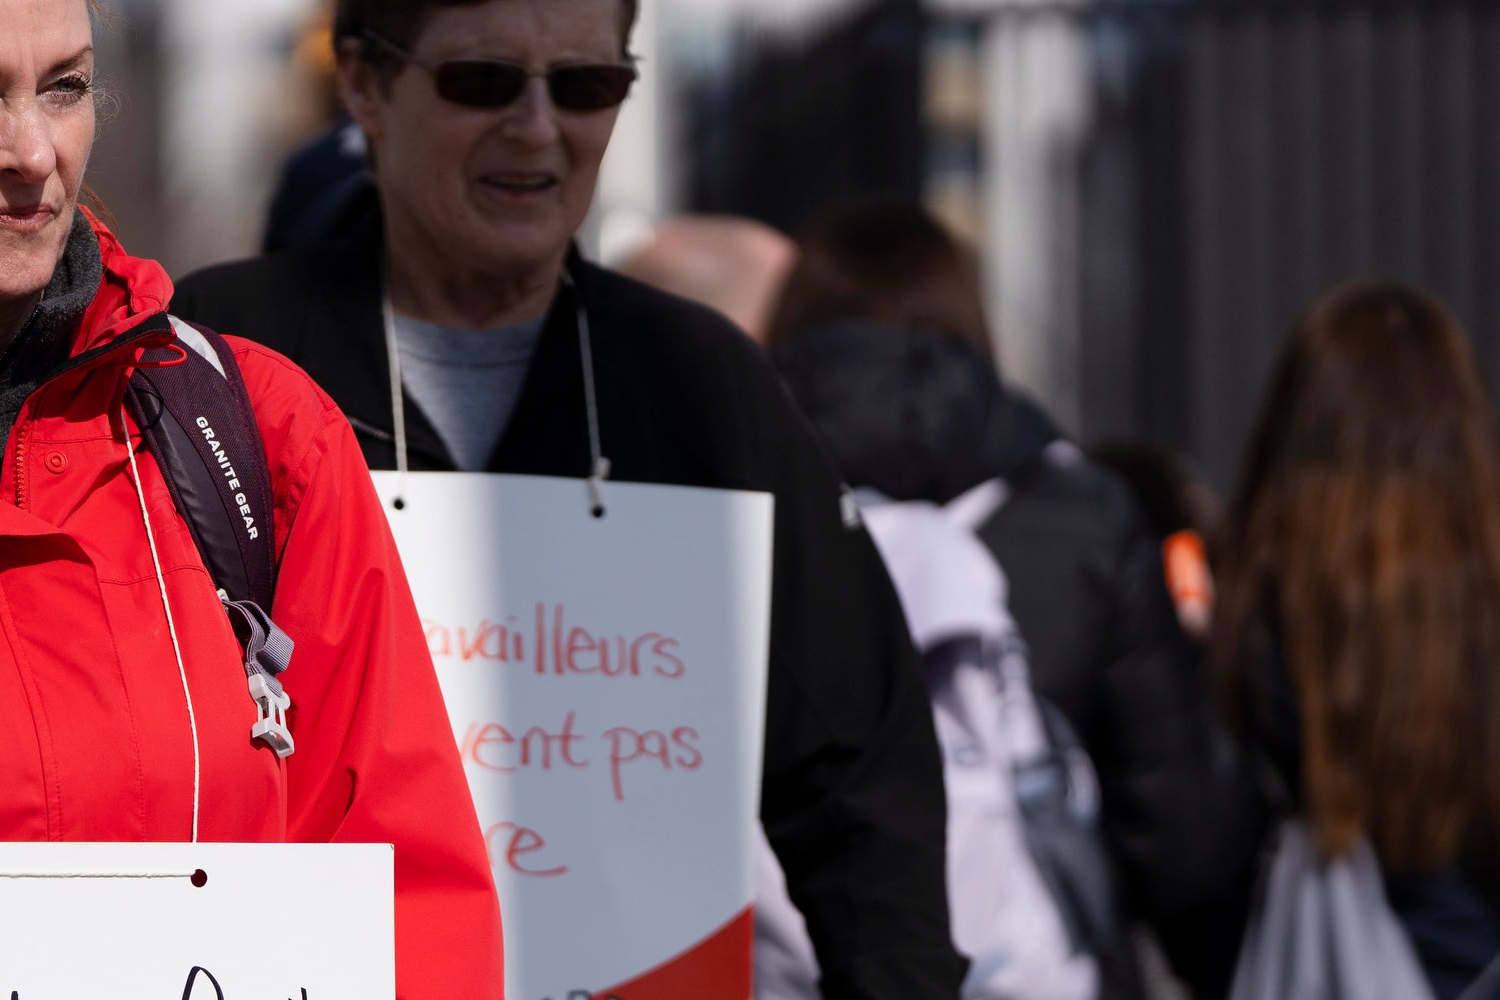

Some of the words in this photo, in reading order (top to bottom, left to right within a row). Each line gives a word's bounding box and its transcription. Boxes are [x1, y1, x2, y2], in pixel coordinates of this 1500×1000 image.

[196, 416, 241, 490] GRANITE
[234, 492, 258, 540] GEAR
[420, 603, 685, 679] availleurs
[602, 725, 703, 802] pas
[485, 820, 568, 877] re
